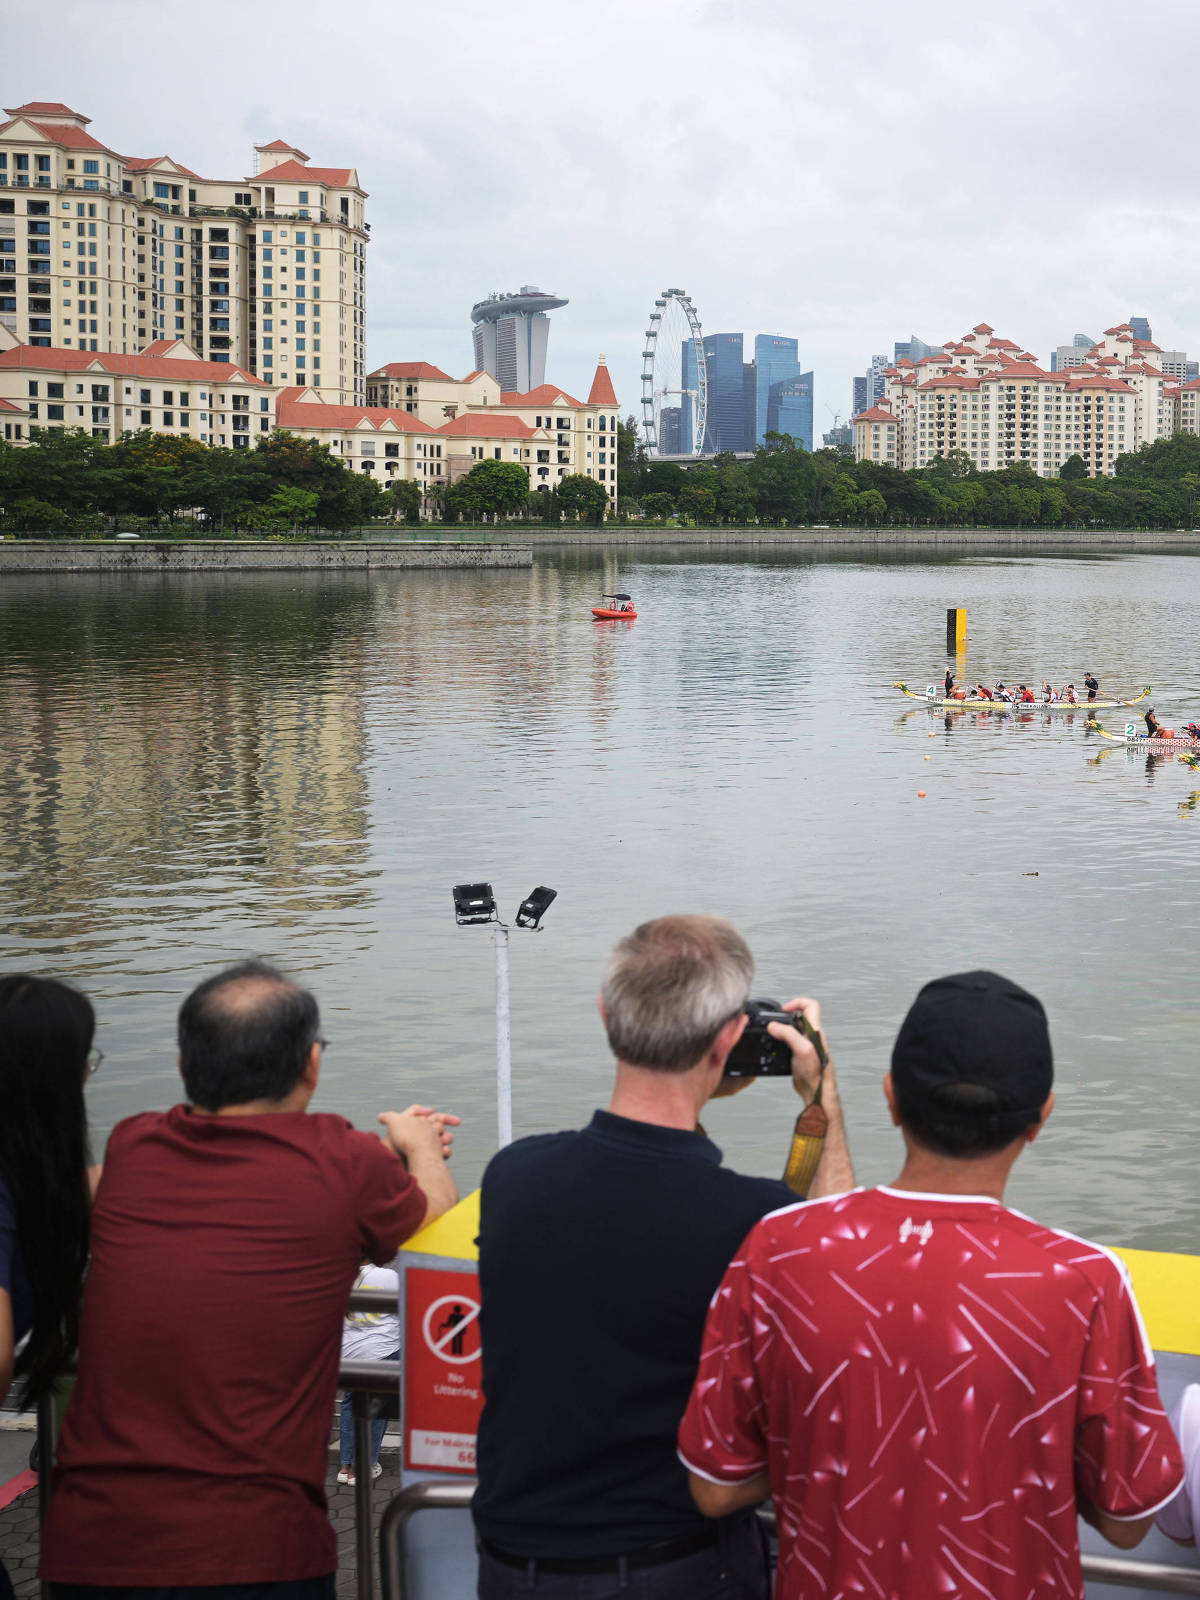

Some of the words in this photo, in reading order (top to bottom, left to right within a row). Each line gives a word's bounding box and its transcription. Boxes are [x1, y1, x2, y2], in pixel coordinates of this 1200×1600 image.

[927, 686, 935, 695] 4
[1127, 725, 1135, 735] 2
[447, 1372, 464, 1383] No
[433, 1385, 478, 1399] Littering
[424, 1437, 440, 1446] For
